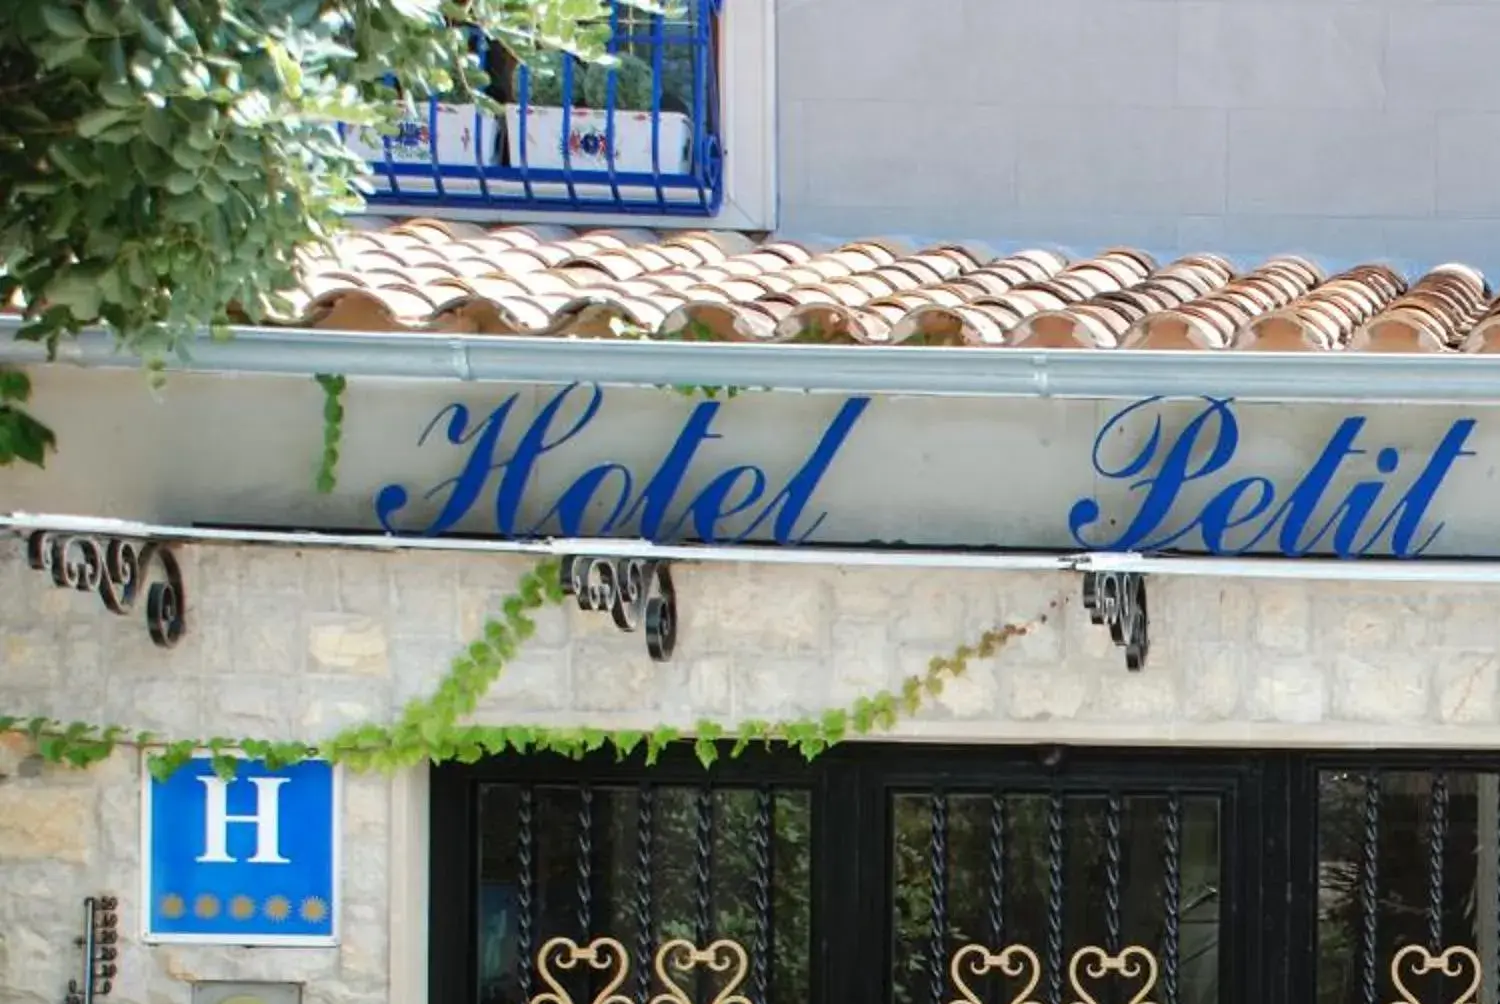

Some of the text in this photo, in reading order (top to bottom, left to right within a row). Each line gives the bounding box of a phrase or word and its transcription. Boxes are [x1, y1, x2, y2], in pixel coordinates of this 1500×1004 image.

[376, 382, 868, 545] Hotel
[1067, 396, 1476, 561] Petit
[195, 775, 291, 864] H
